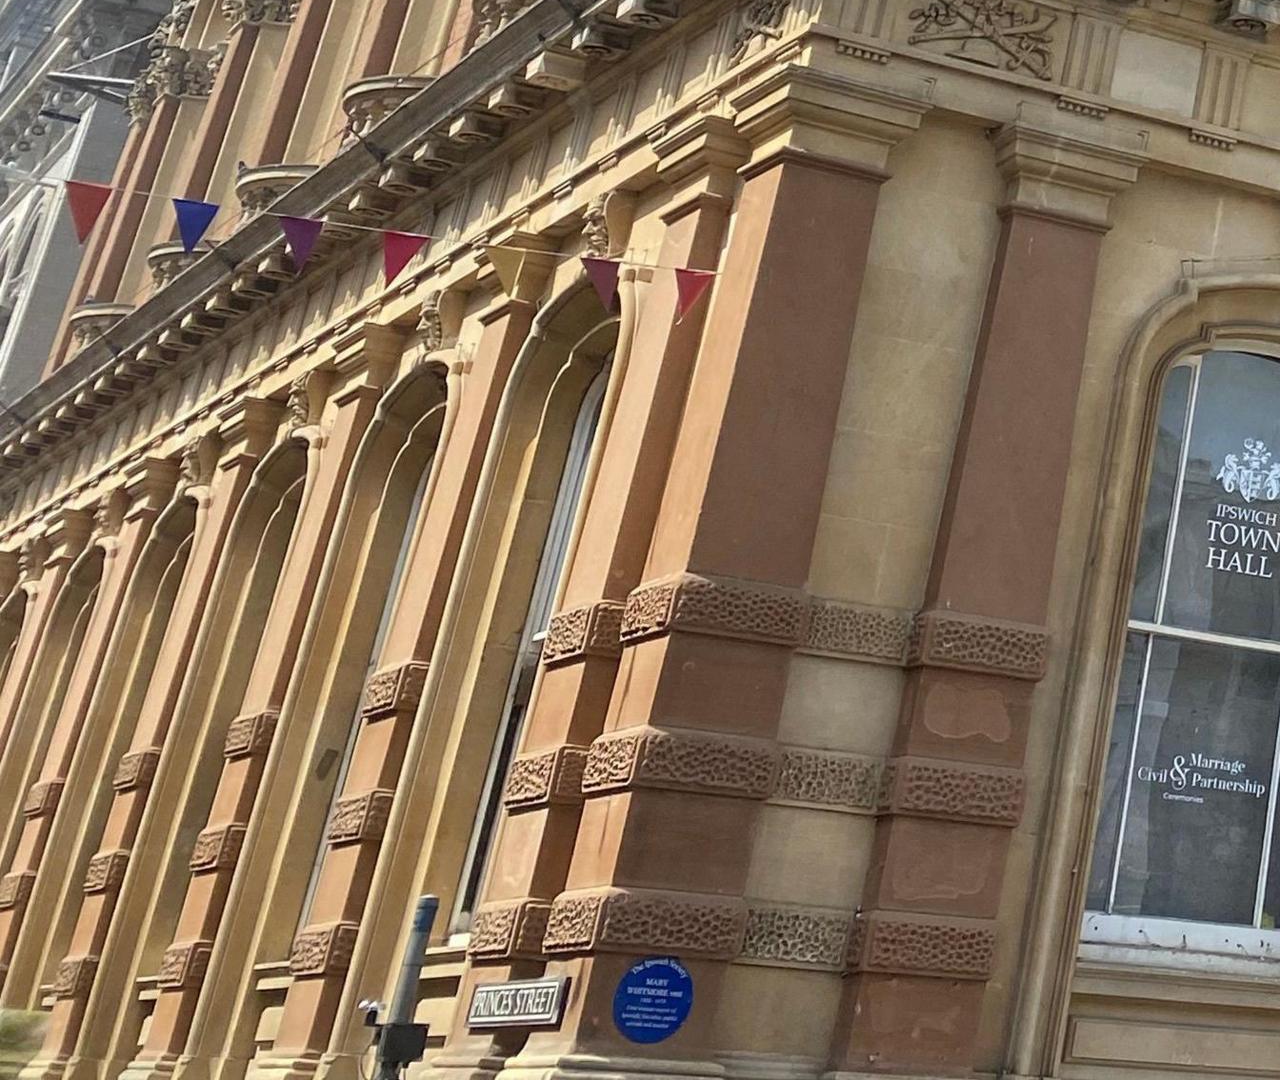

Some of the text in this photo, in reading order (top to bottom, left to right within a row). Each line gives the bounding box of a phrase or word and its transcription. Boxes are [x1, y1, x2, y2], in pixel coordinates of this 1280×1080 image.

[1216, 504, 1277, 526] IPSWICH
[1205, 547, 1272, 578] HALL
[1137, 755, 1266, 798] Civil & Partnership
[1189, 753, 1246, 775] Marriage
[472, 987, 556, 1017] PRINCES STREET
